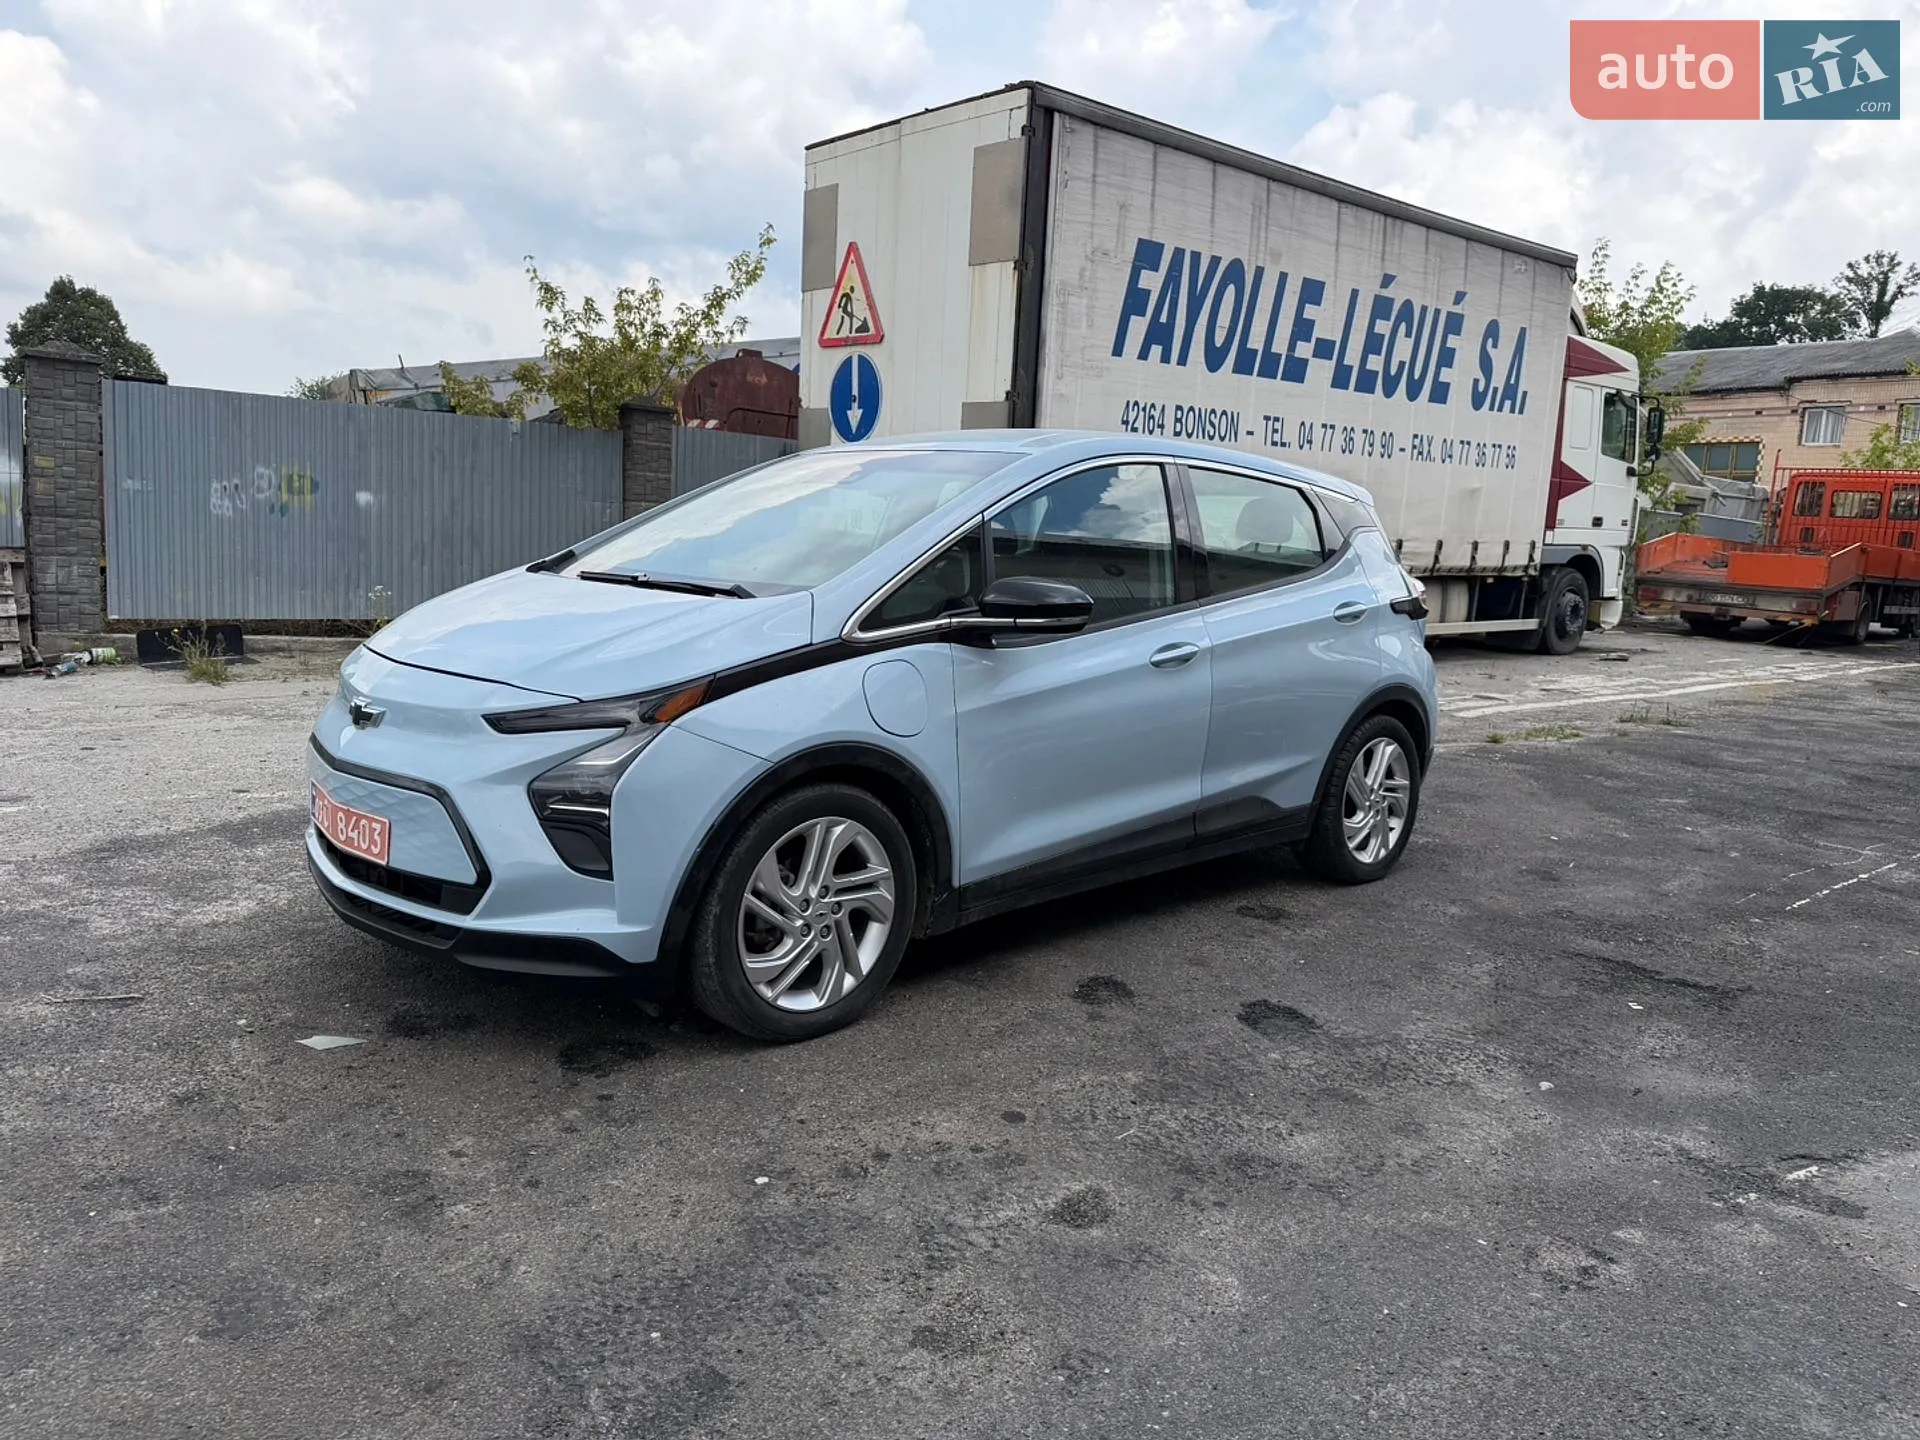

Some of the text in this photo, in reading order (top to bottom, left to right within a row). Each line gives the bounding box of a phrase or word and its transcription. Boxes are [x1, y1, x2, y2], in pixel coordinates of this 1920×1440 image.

[1111, 237, 1529, 416] FAYOLLE-LÉCUÉ S.A.
[1120, 399, 1166, 436] 42164
[1172, 404, 1240, 443] BONSON
[1262, 414, 1291, 449] TEL.
[1298, 420, 1314, 451] 04
[1320, 422, 1336, 453] 77
[1341, 425, 1356, 456] 36
[1361, 428, 1375, 459] 79
[1379, 431, 1395, 460] 90
[1410, 433, 1436, 463] FAX.
[1440, 437, 1454, 465] 04
[1458, 439, 1472, 466] 77
[1475, 442, 1487, 468] 36
[1490, 443, 1503, 470] 77
[1505, 445, 1517, 470] 56
[337, 811, 382, 855] 8403
